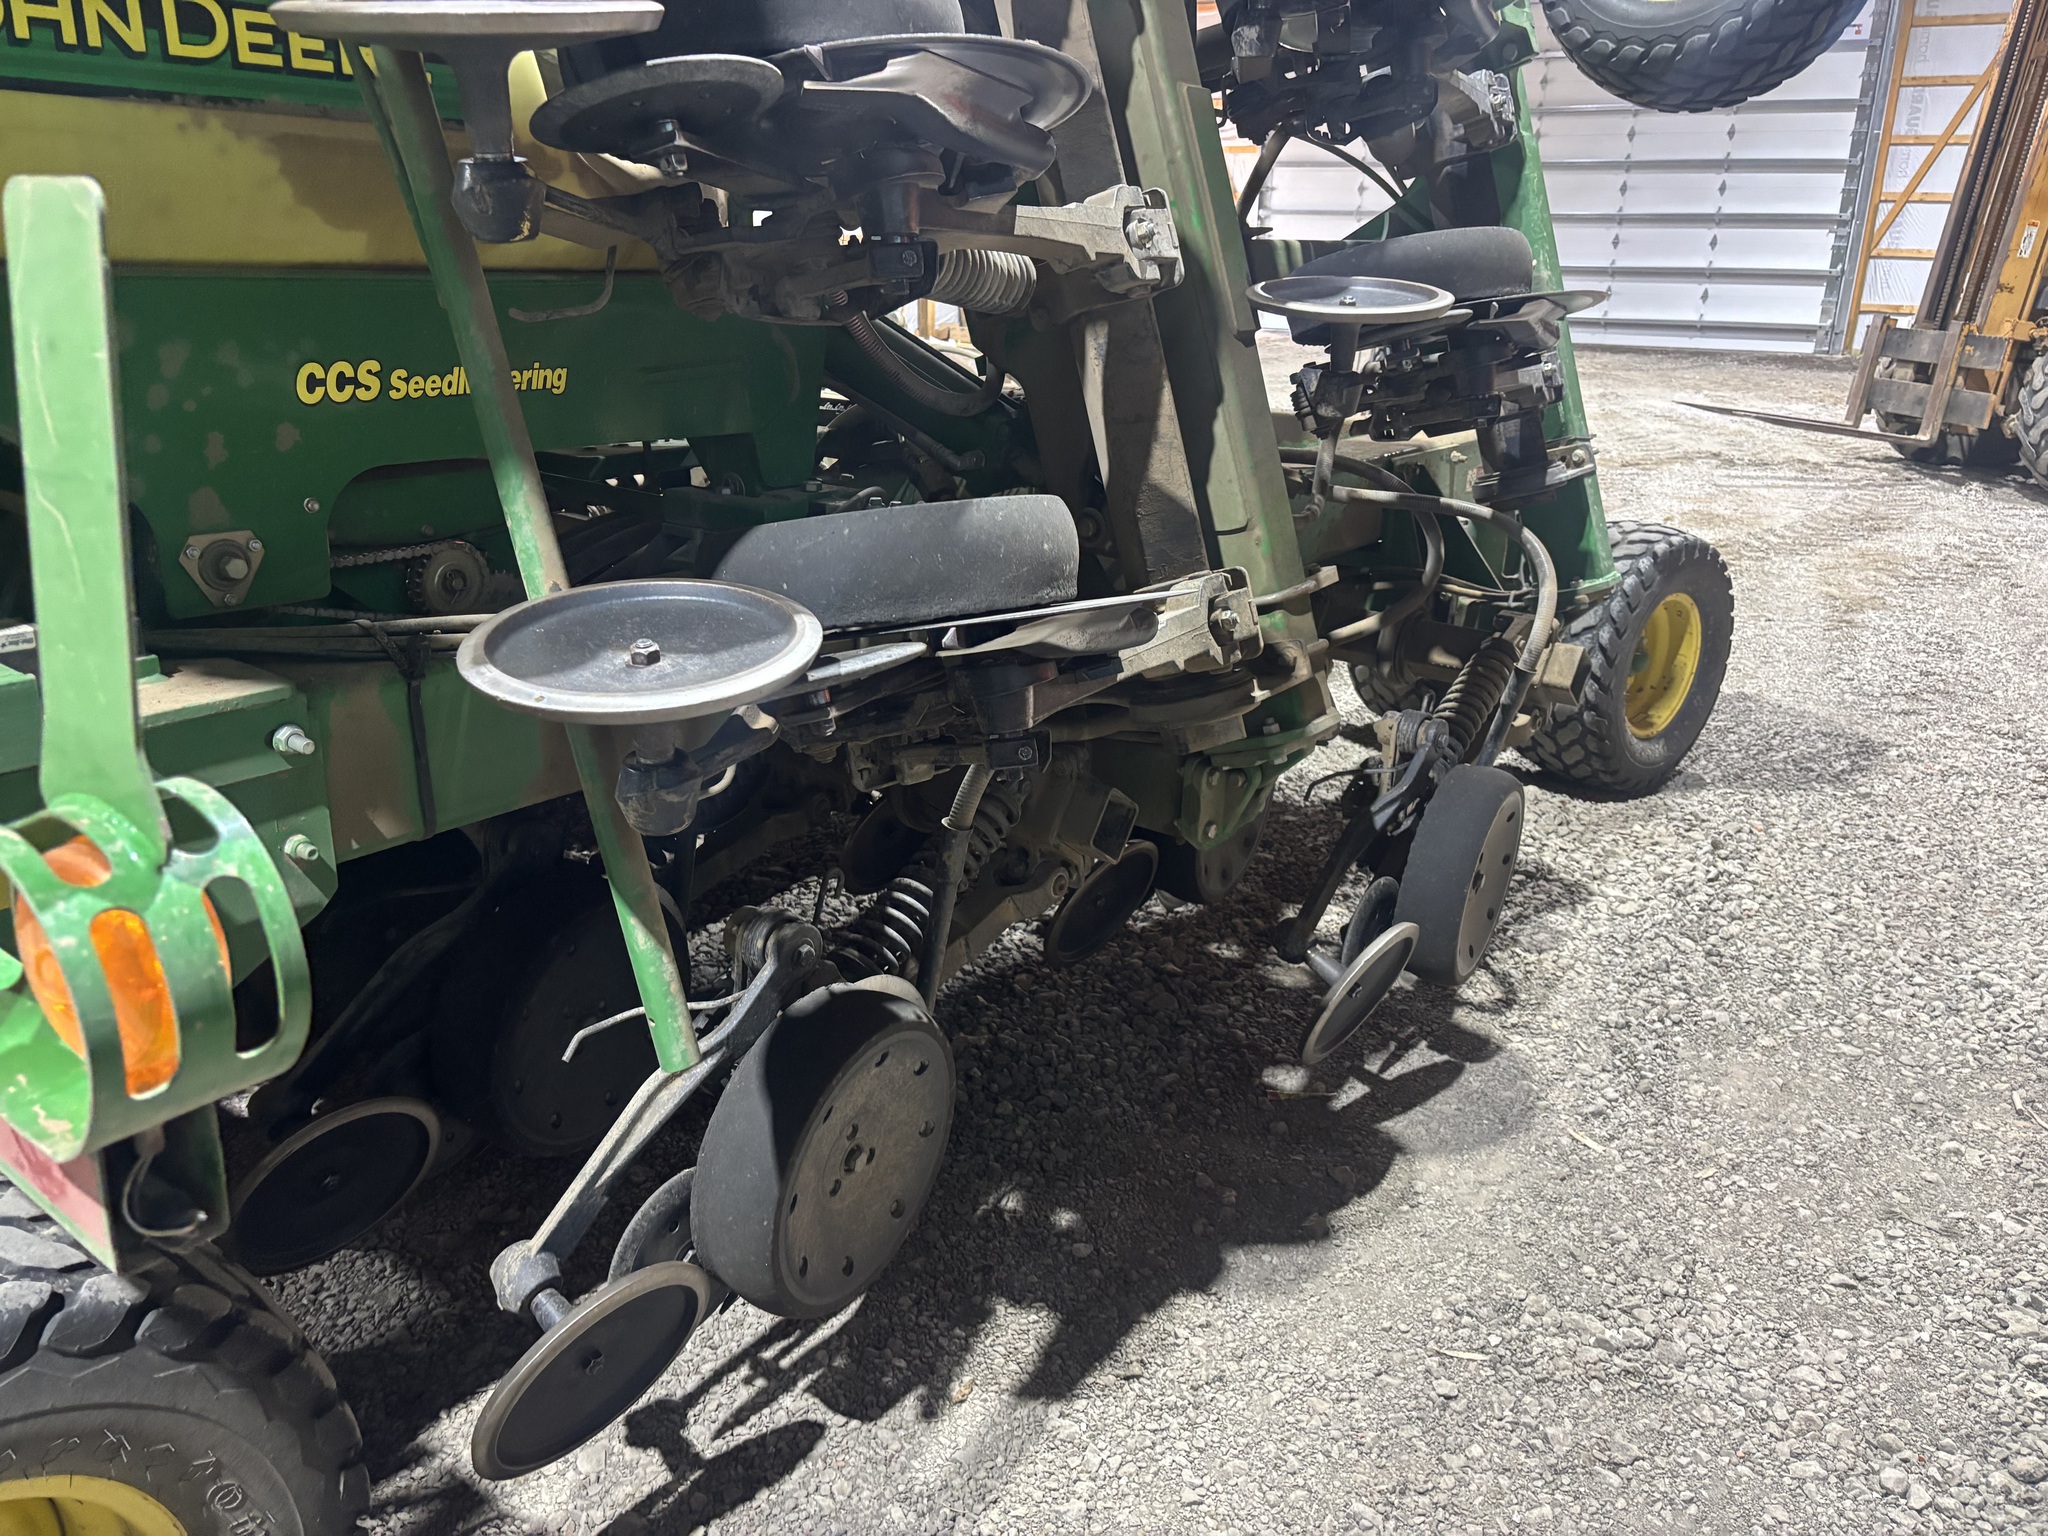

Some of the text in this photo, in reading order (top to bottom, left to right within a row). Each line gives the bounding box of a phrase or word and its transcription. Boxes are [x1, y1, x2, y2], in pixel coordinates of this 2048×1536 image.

[0, 0, 433, 84] HN DEE
[296, 360, 568, 404] CCS Seedering
